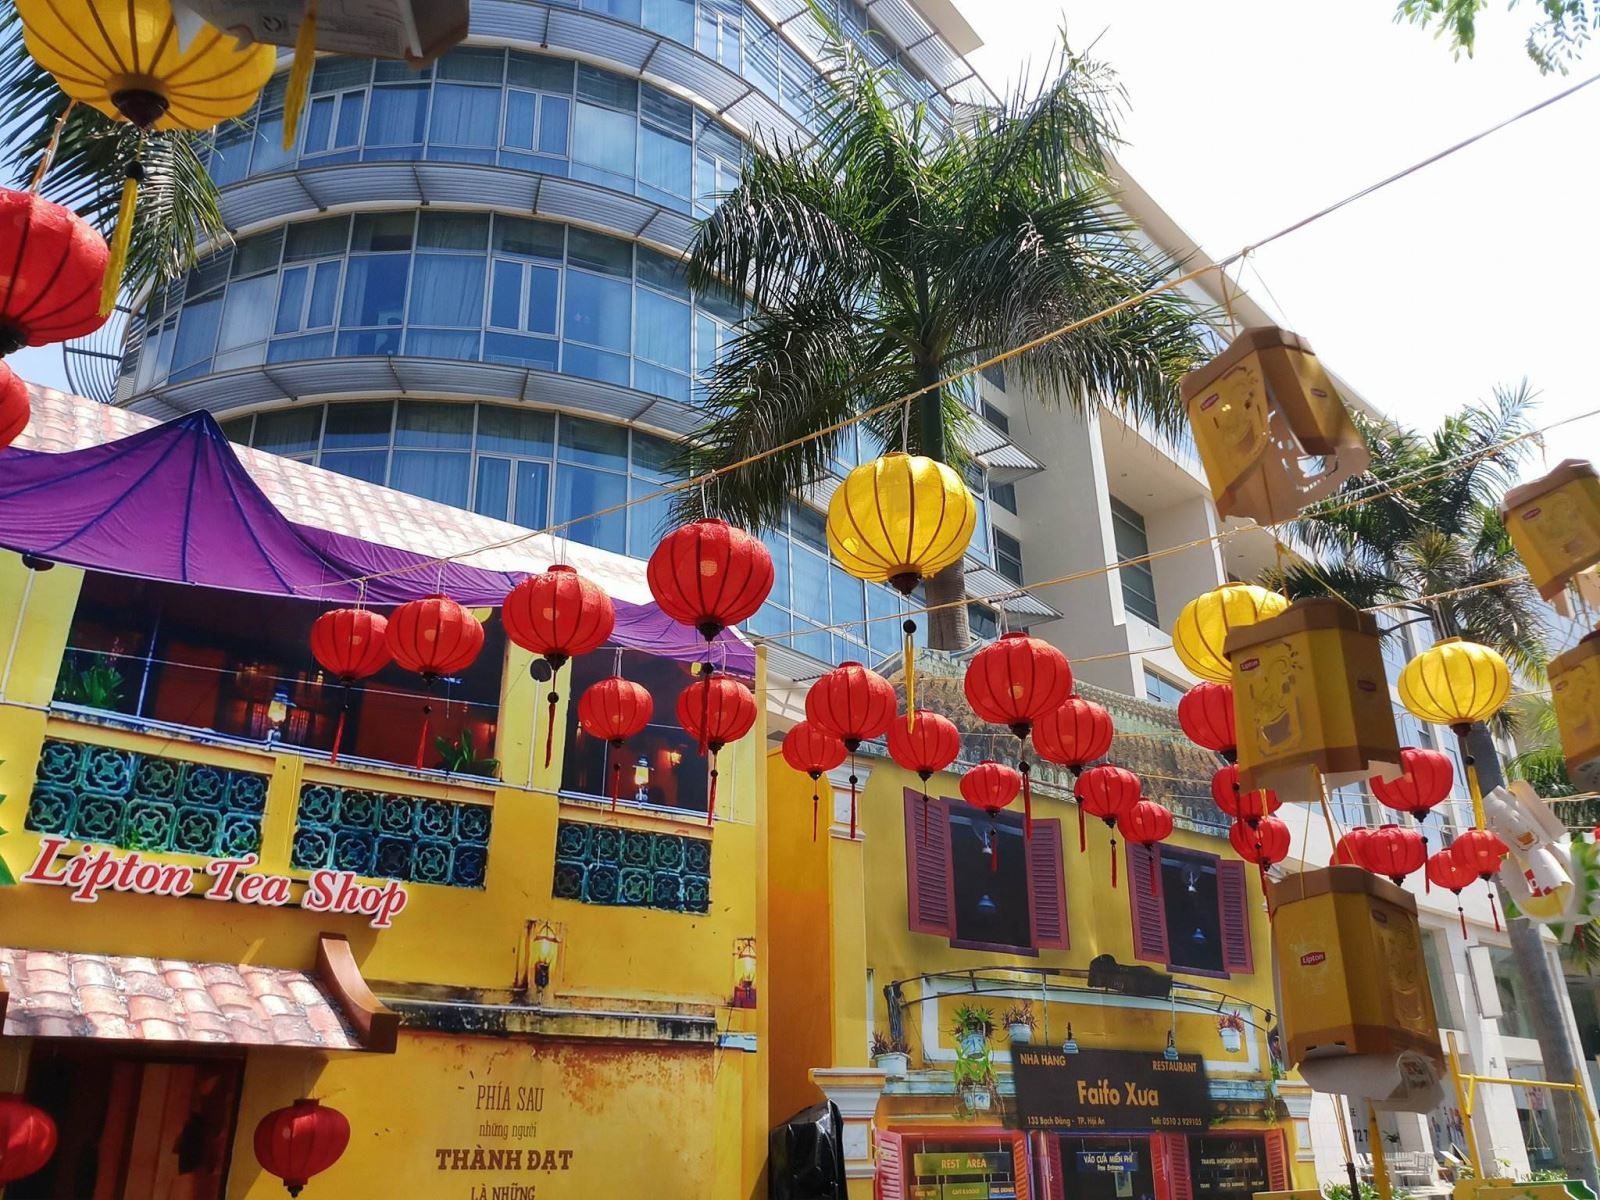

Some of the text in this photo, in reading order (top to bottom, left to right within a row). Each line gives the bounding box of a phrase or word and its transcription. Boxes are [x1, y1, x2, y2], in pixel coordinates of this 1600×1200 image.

[24, 837, 407, 926] Lipton Tea Shop
[1302, 954, 1324, 964] Lipton
[1020, 1051, 1067, 1066] NHÀ HÀNG
[1152, 1060, 1197, 1073] RESTAURANT
[475, 1081, 545, 1112] PHÍA SAU
[1077, 1079, 1159, 1106] Faifo Xưa
[1027, 1116, 1039, 1125] 133
[479, 1120, 538, 1140] những người
[435, 1144, 573, 1174] THÀNH ĐẠT
[941, 1158, 987, 1169] REST AREA
[471, 1182, 536, 1200] LÀ NHỮNG
